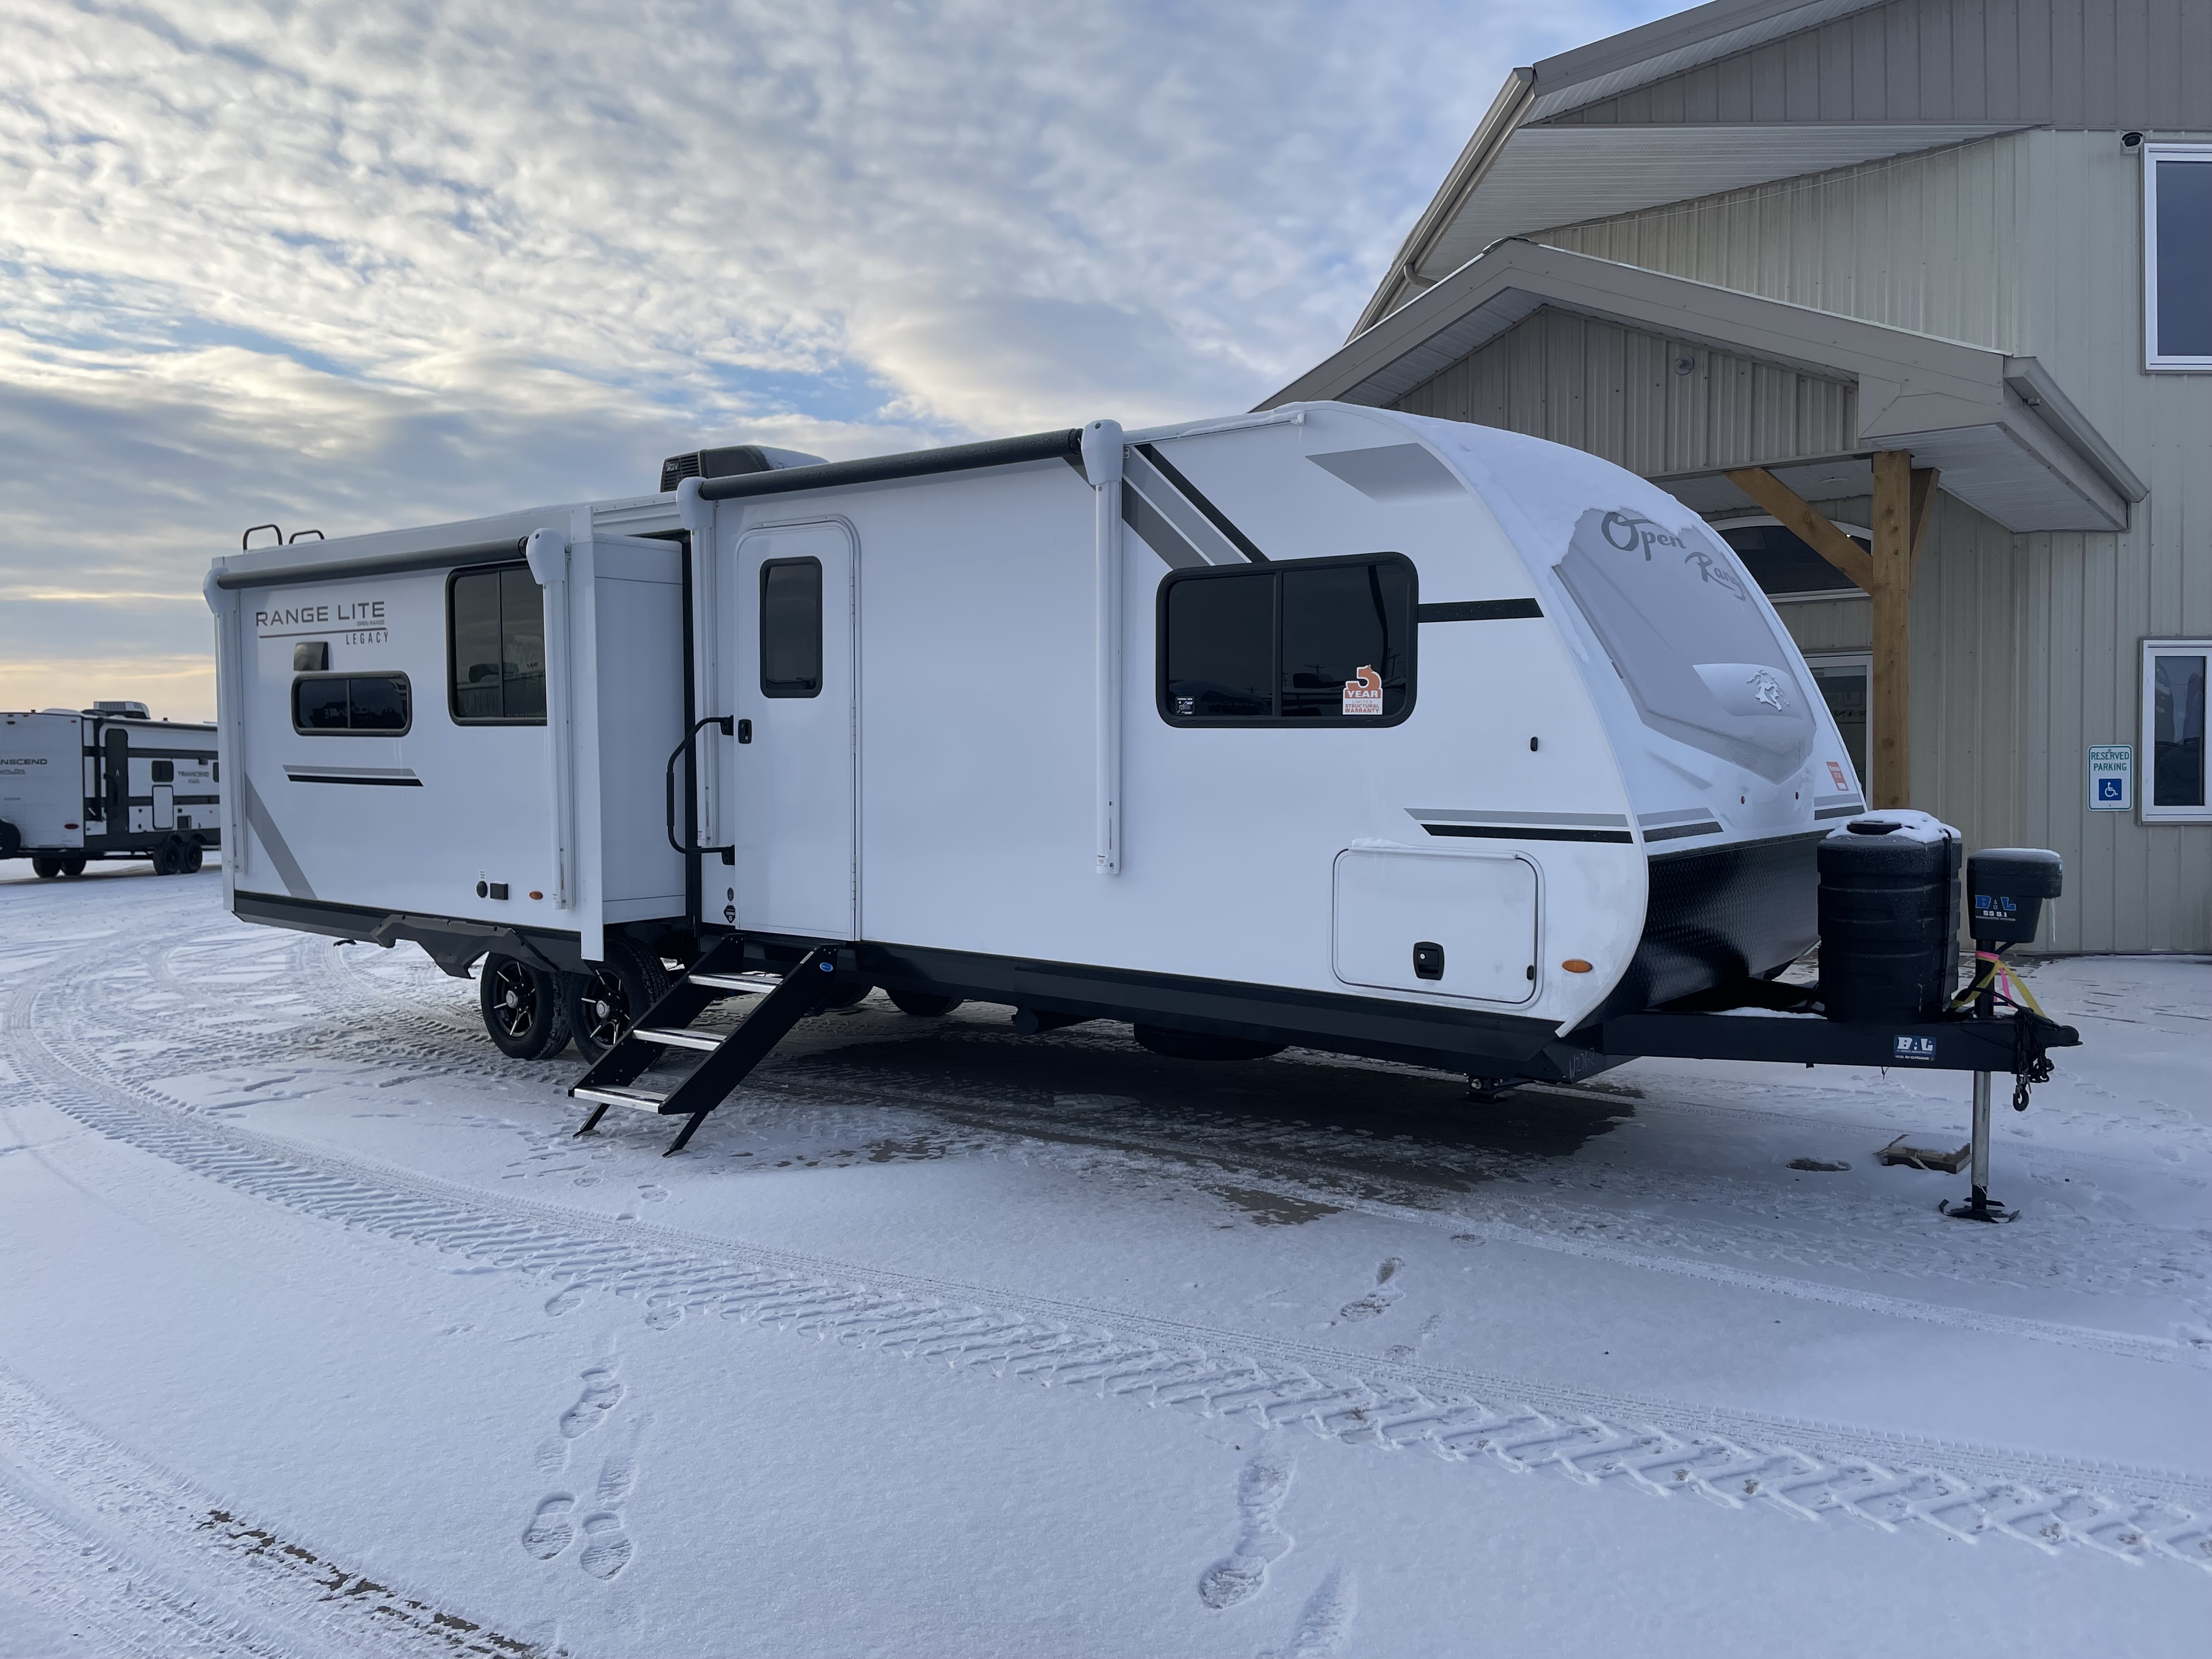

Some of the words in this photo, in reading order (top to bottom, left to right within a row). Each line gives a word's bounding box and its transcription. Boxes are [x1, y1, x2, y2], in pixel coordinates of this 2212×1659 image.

[1601, 511, 1686, 561] Open
[1684, 551, 1746, 601] Rang
[256, 606, 329, 627] RANGE
[338, 601, 385, 620] LITE
[346, 631, 388, 645] LEGACY
[1346, 664, 1381, 690] 5
[2091, 752, 2130, 760] RESERVED
[2094, 763, 2127, 771] PARKING
[1974, 894, 2017, 911] BAL
[1897, 1036, 1933, 1051] BAL
